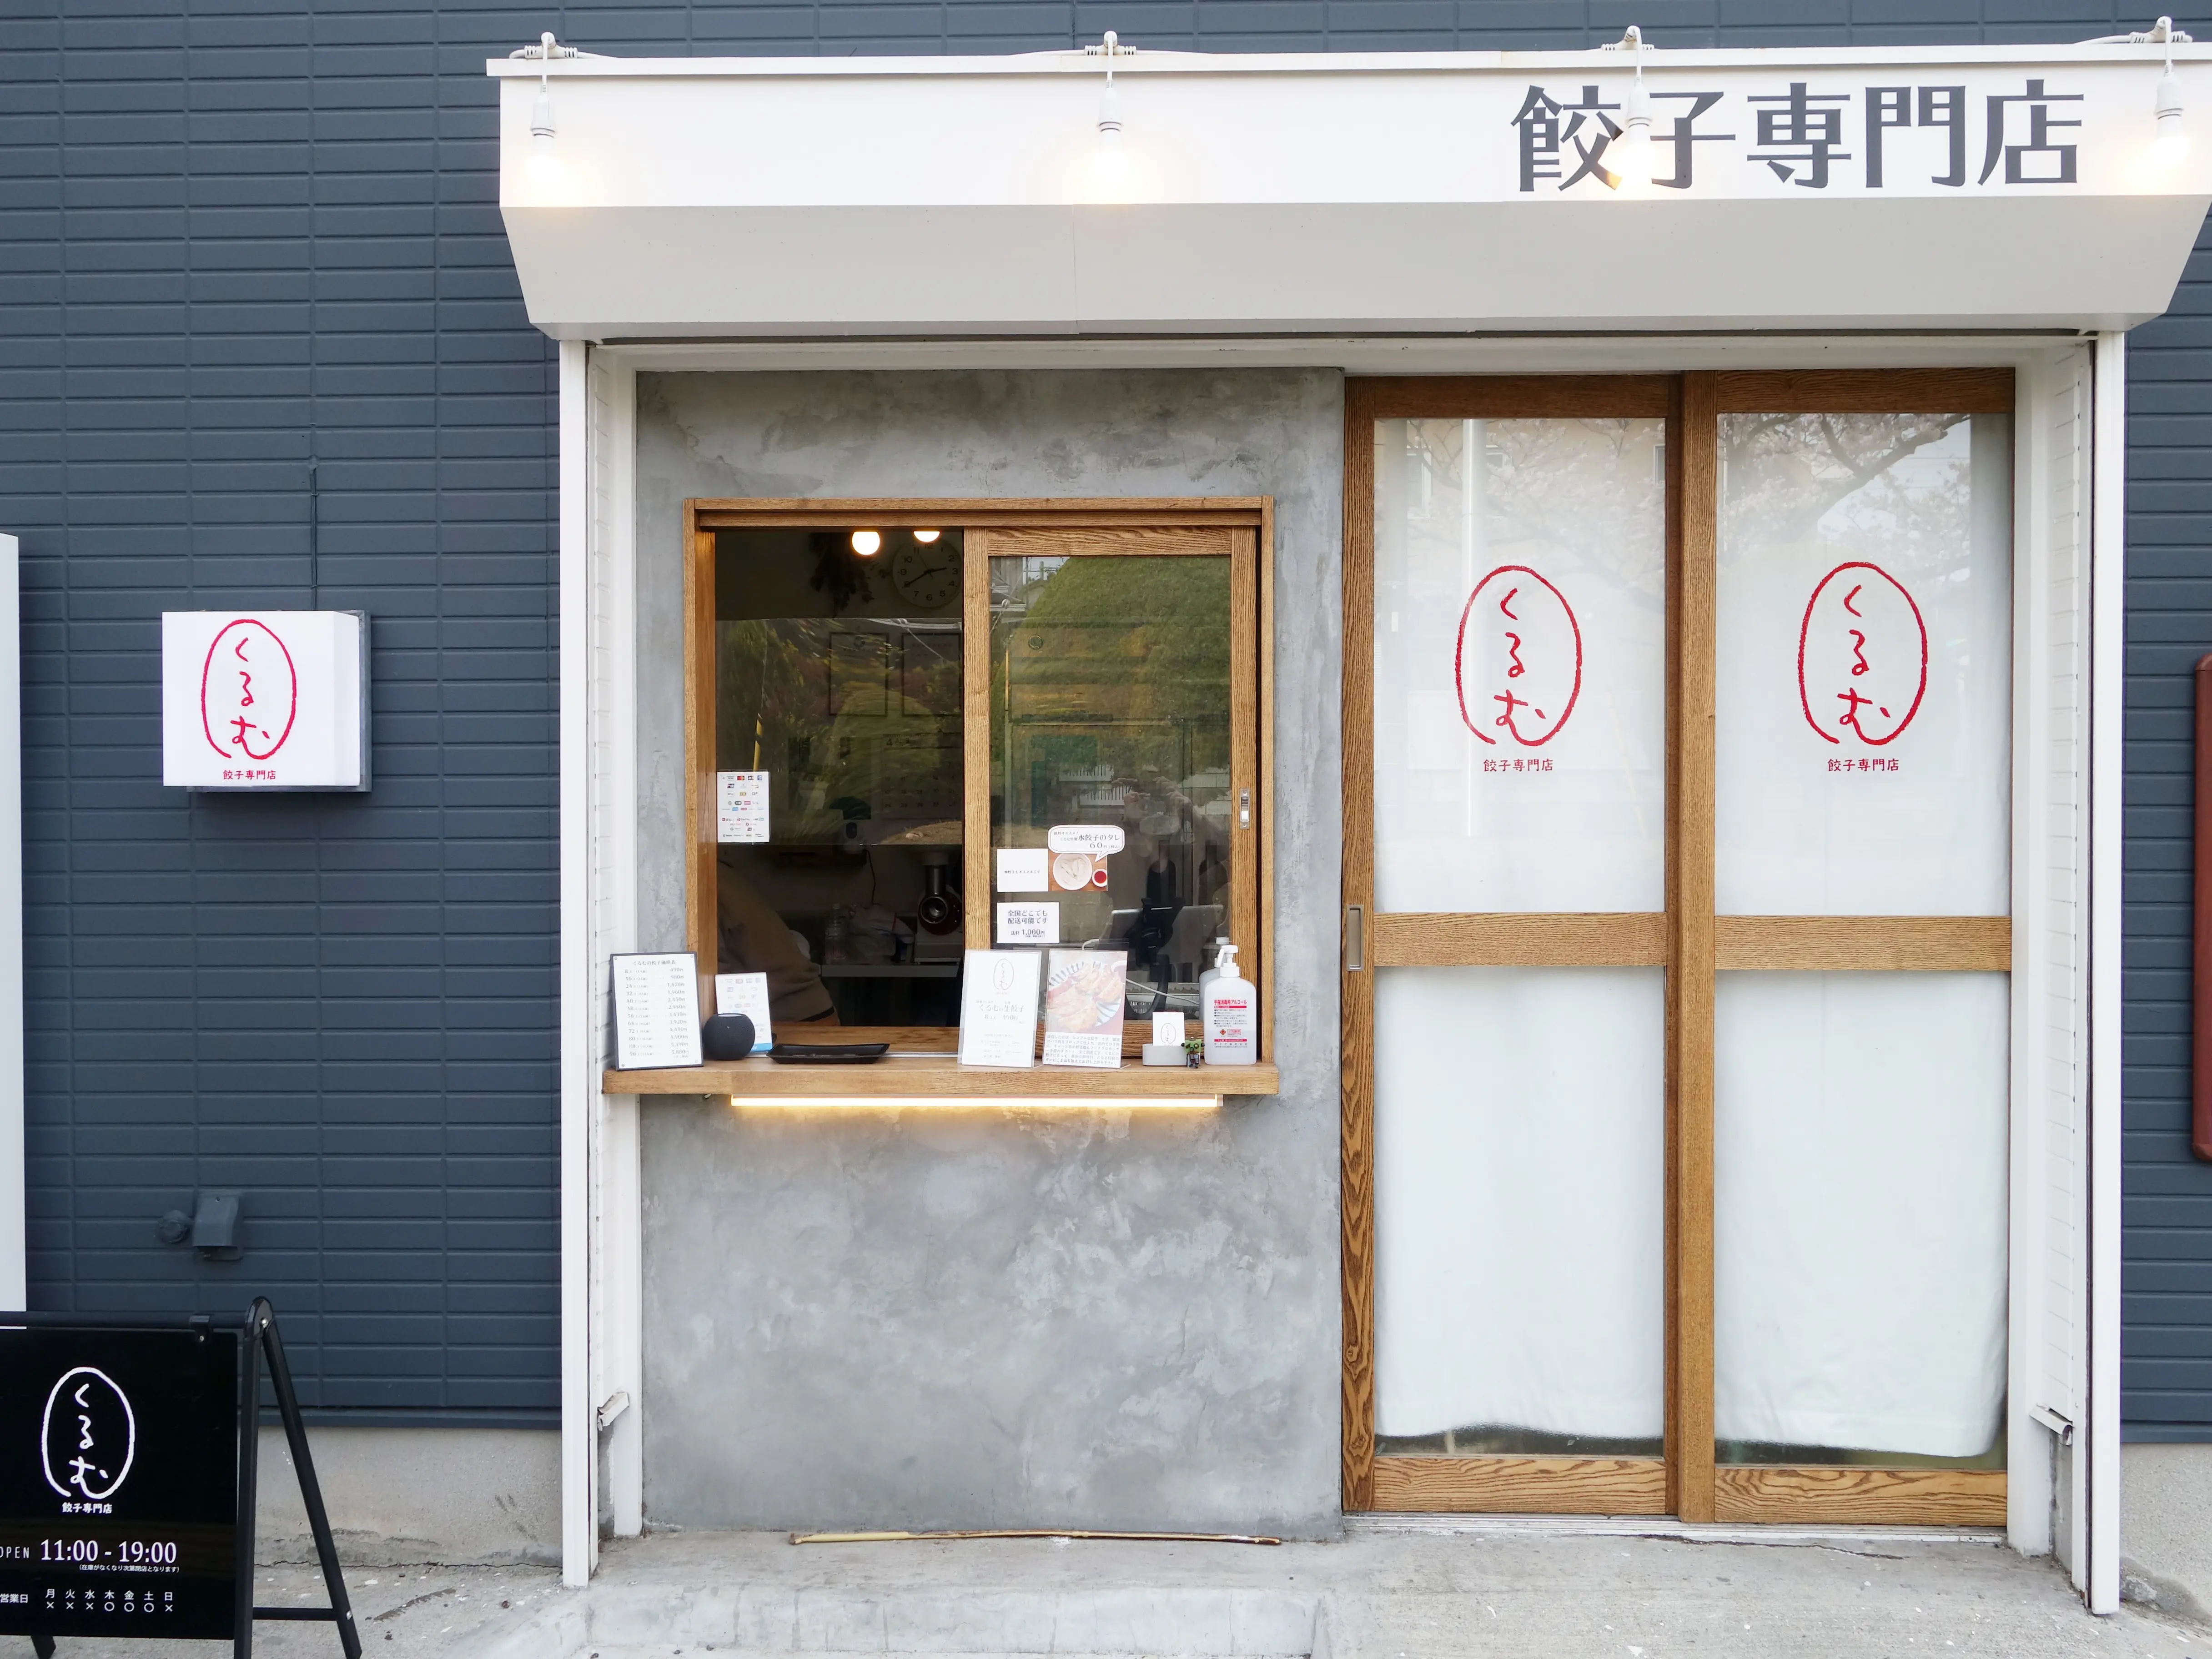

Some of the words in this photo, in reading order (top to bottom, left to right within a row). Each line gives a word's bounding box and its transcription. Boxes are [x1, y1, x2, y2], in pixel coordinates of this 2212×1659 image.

[1511, 79, 2084, 192] 餃子専門店
[1493, 588, 1546, 746] くるむ
[1837, 584, 1890, 745] くるむ
[231, 638, 270, 759] くるむ
[223, 769, 276, 780] 餃子専門店
[1483, 759, 1553, 772] 餃子専門店
[1828, 758, 1900, 772] 餃子専門店
[69, 1384, 108, 1499] くるむ
[62, 1502, 113, 1514] 餃子専門店
[41, 1539, 99, 1561] 11:00
[119, 1541, 177, 1563] 19:00
[0, 1594, 28, 1604] 営業日
[45, 1589, 55, 1599] 月
[65, 1589, 75, 1599] 火
[85, 1589, 95, 1599] 水
[104, 1590, 115, 1599] 木
[124, 1590, 134, 1600] 金
[144, 1591, 154, 1601] 土
[164, 1592, 173, 1601] 日
